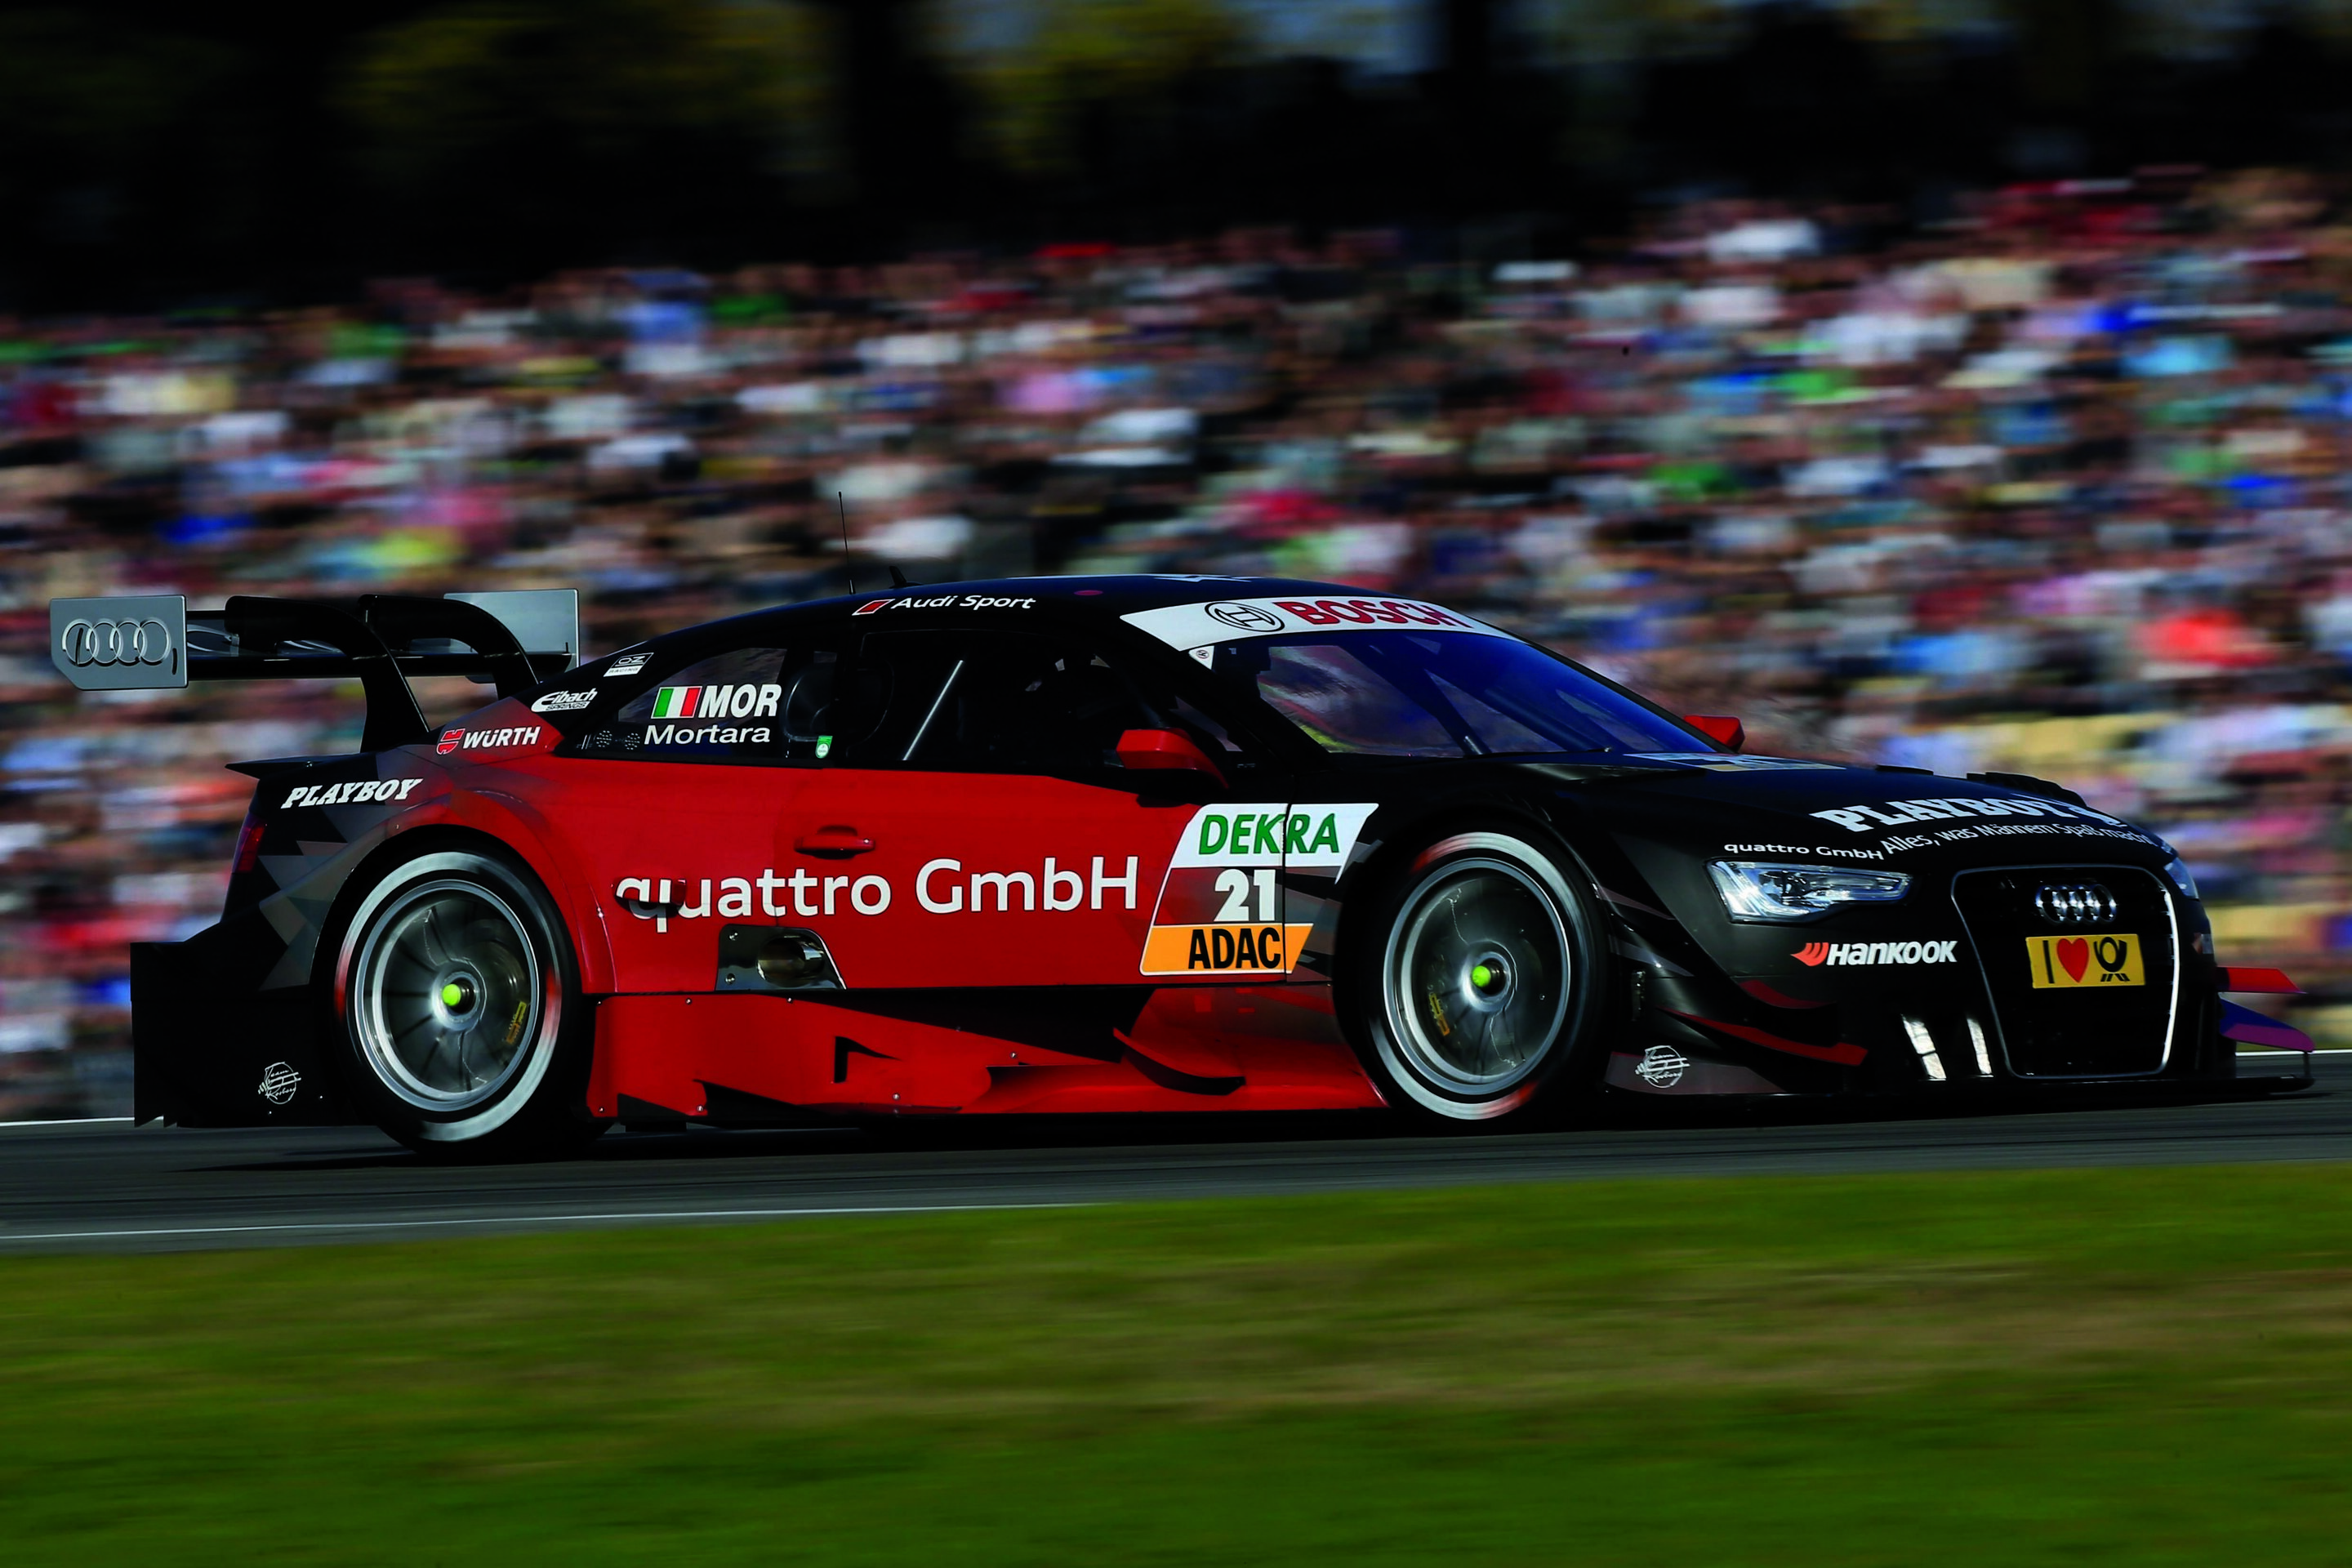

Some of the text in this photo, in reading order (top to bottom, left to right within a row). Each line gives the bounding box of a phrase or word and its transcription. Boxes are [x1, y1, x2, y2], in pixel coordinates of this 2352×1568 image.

[891, 595, 1036, 610] Audi Sport
[1272, 599, 1474, 629] BOSCH
[618, 656, 645, 664] OZ
[531, 688, 598, 712] Eibach
[698, 684, 782, 718] MOR
[463, 726, 541, 749] WÜRTH
[644, 724, 770, 745] Mortara
[280, 778, 423, 808] PLAYBOY
[1809, 798, 2079, 832] PLAYBOY
[1199, 813, 1339, 854] DEKRA
[1881, 831, 1939, 854] Alles,
[1936, 829, 1979, 841] was
[1724, 844, 1884, 860] quattro GmbH
[616, 856, 1138, 933] quattro GmbH
[1214, 869, 1276, 922] 21
[1188, 927, 1281, 969] ADAC
